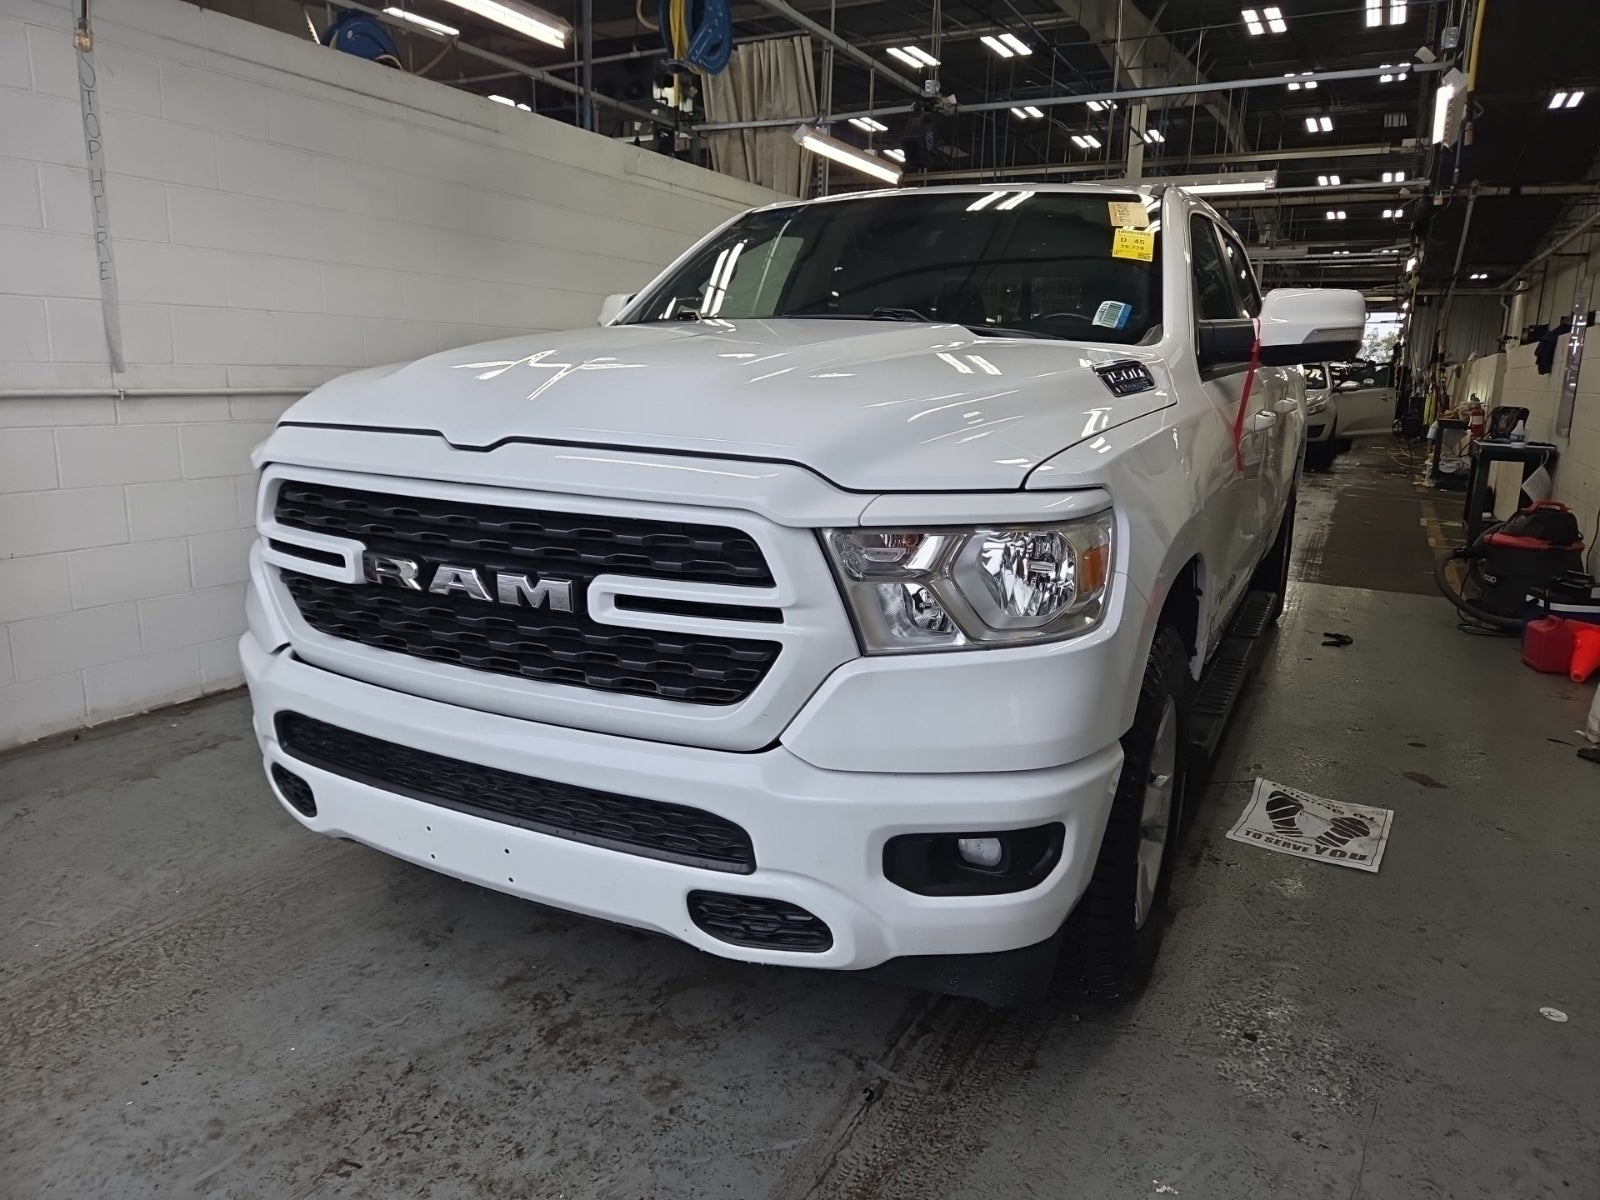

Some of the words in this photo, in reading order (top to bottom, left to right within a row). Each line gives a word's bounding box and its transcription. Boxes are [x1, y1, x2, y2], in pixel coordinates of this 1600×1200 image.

[80, 52, 102, 161] STOP
[90, 168, 112, 281] HERE
[363, 552, 574, 613] RAM
[1244, 829, 1263, 840] TO
[1263, 836, 1311, 853] SERVE
[1314, 844, 1368, 861] YOU
